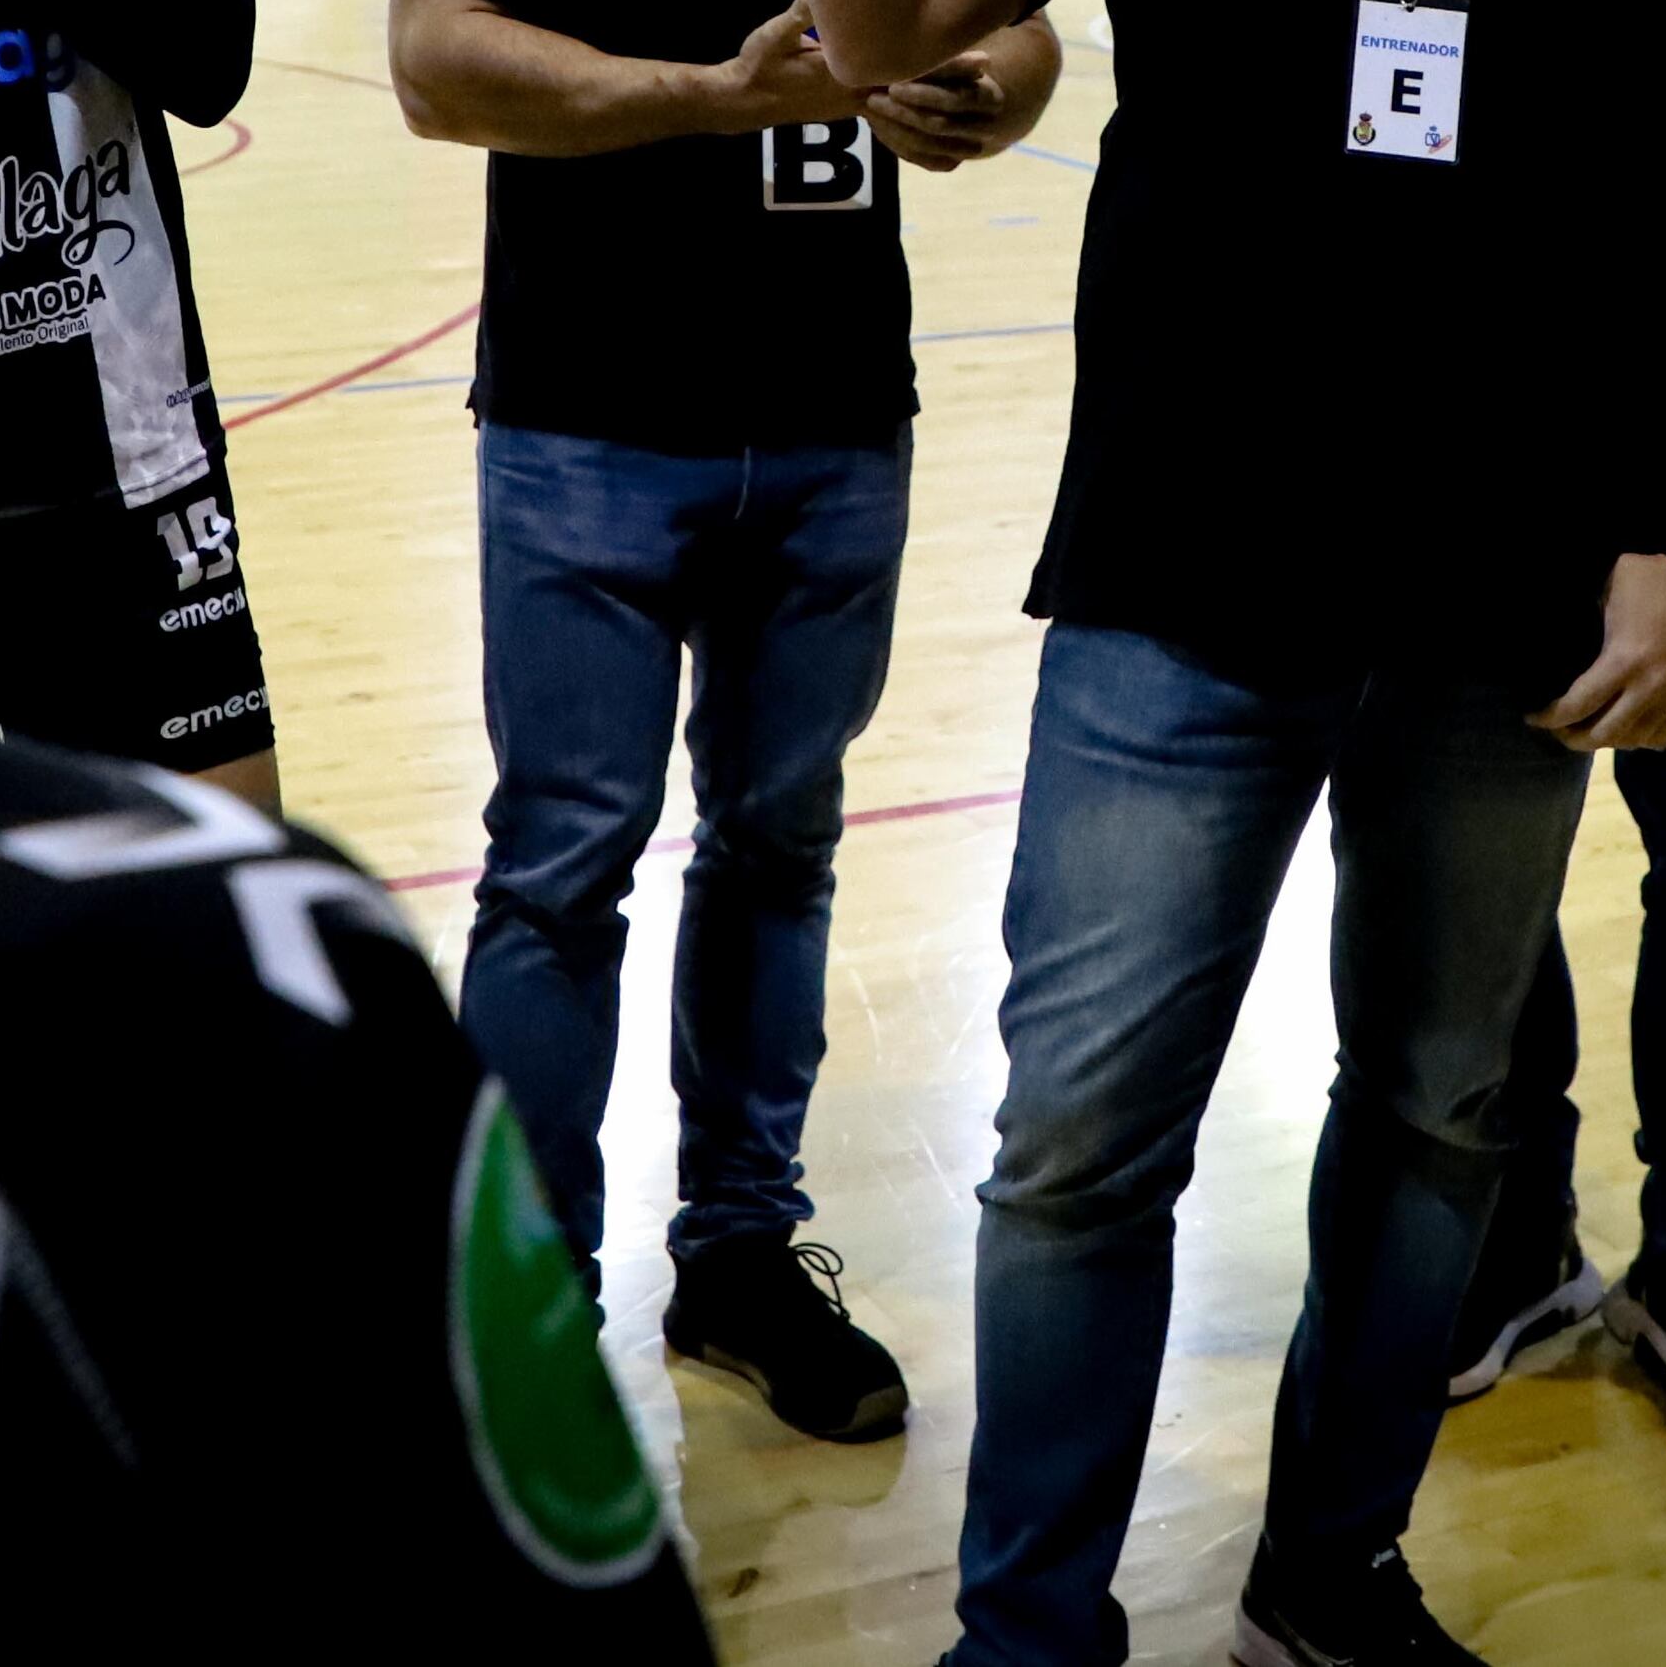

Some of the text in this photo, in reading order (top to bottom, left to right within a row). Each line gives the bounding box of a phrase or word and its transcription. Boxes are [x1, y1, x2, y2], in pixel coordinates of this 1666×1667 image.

[1361, 35, 1460, 58] ENTRENADOR
[1391, 69, 1424, 115] E
[6, 274, 108, 325] MODA
[39, 316, 91, 342] Original
[157, 496, 234, 591] 19
[159, 592, 236, 632] emec
[160, 692, 263, 739] emec
